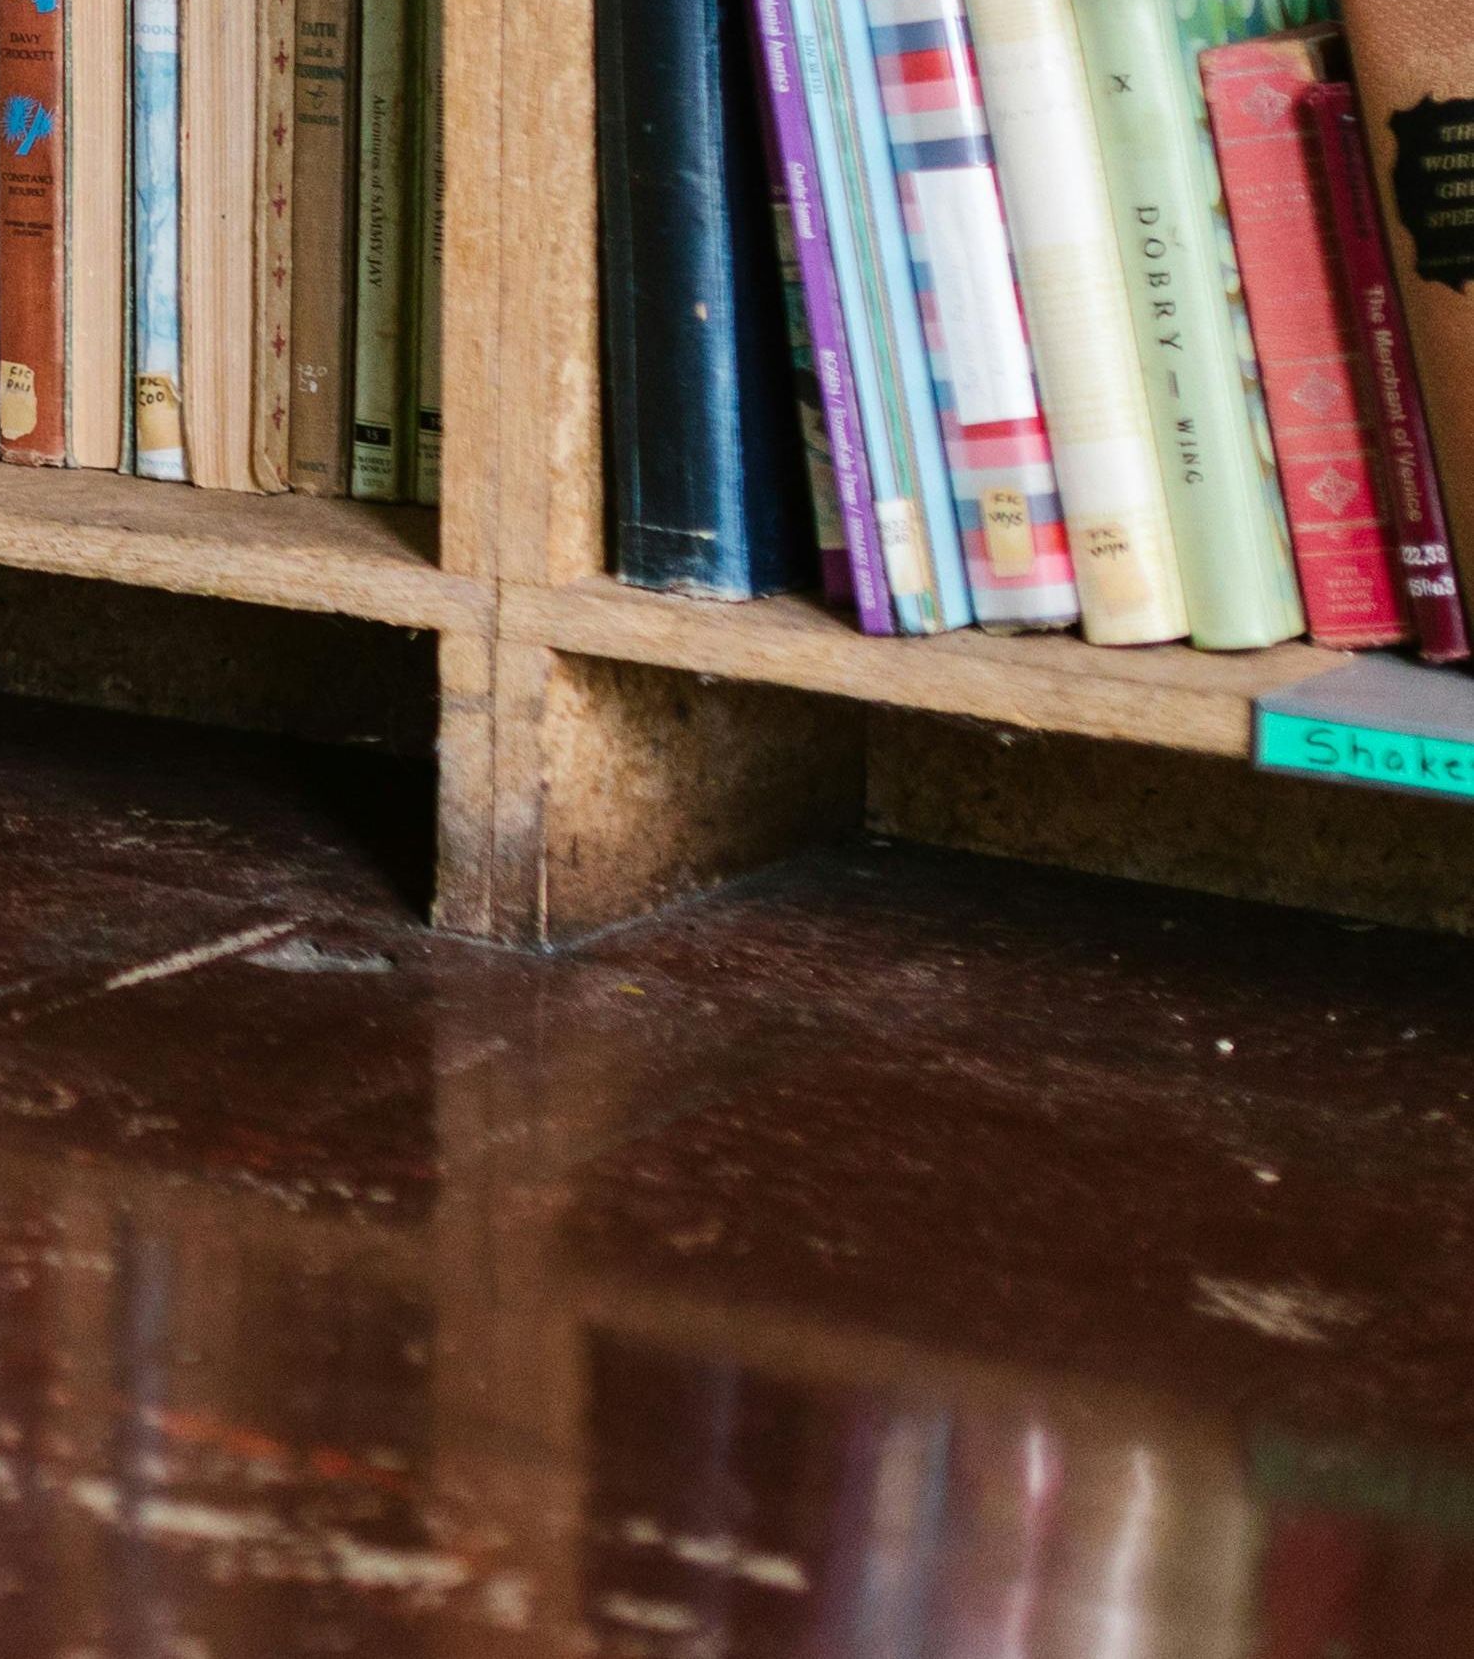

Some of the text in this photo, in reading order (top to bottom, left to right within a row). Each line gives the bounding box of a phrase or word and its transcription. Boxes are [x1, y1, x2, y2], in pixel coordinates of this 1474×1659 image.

[0, 48, 57, 63] CROCKETT
[10, 31, 43, 46] DAVY
[765, 38, 792, 94] America
[366, 95, 386, 286] Adventures of SAMMY JAY
[1133, 203, 1205, 484] DOBRY WING
[1364, 284, 1428, 523] The Merchant of Venice
[1305, 727, 1472, 783] Shake
